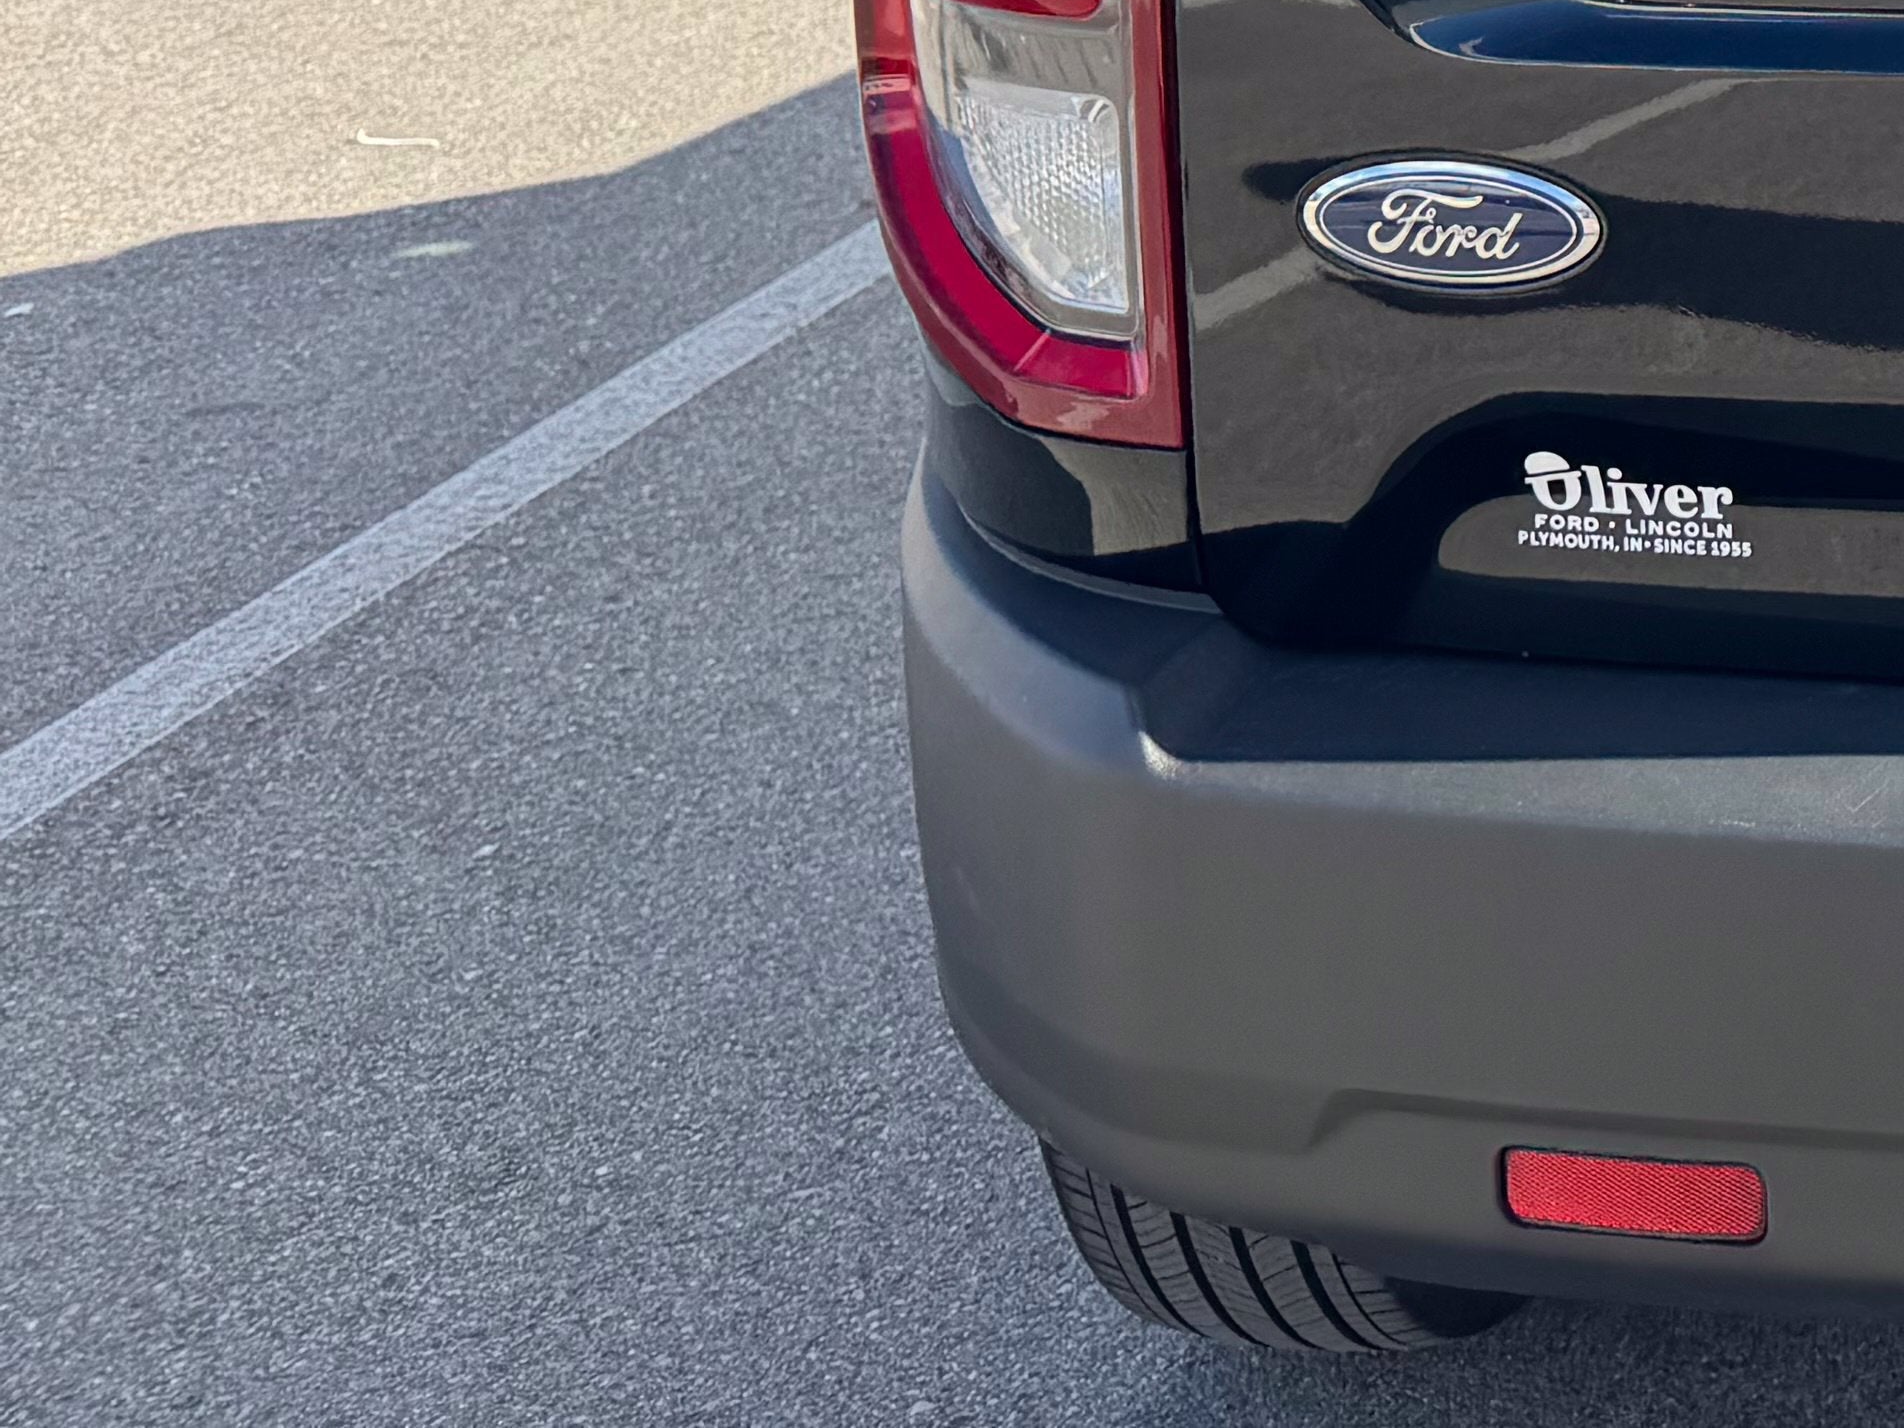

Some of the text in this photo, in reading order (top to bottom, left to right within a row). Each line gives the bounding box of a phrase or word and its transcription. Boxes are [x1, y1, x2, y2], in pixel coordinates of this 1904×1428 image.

[1366, 187, 1525, 262] Ford
[1523, 450, 1734, 520] Oliver
[1517, 530, 1620, 553] PLYMOUTH,
[1710, 541, 1753, 558] 1955
[1534, 513, 1733, 540] FORD LINCOLN
